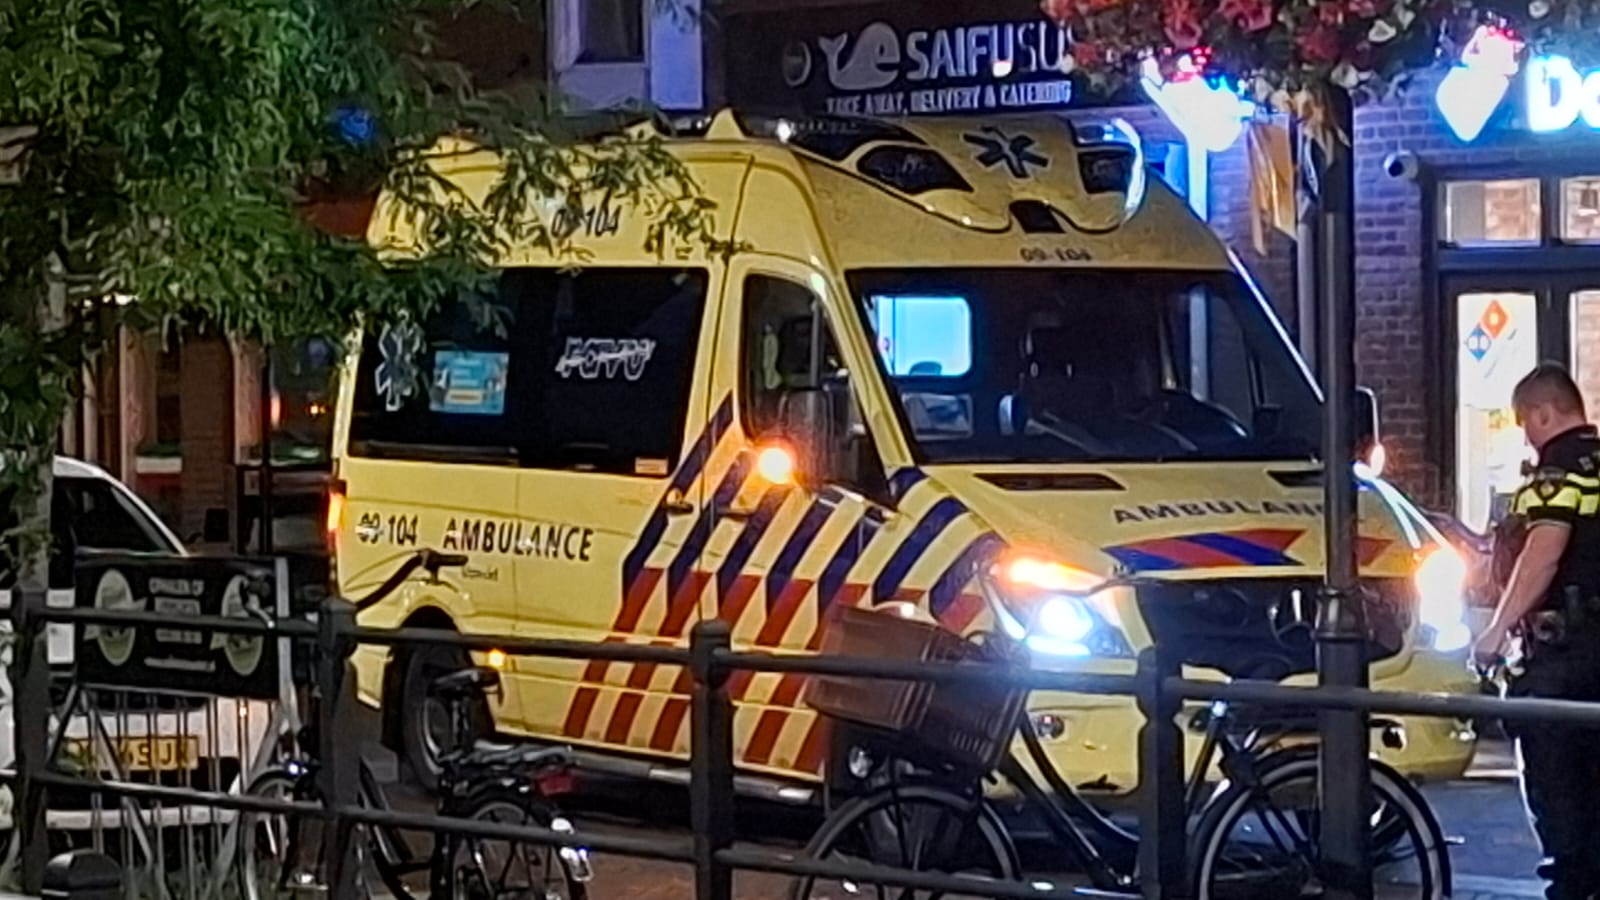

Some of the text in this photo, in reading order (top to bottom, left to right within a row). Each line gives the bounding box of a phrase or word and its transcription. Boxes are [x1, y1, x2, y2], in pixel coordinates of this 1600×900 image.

[910, 85, 980, 112] DELIVERY
[1001, 80, 1072, 105] CATERING
[1112, 501, 1325, 524] AMBULAN
[442, 517, 594, 561] AMBULANCE
